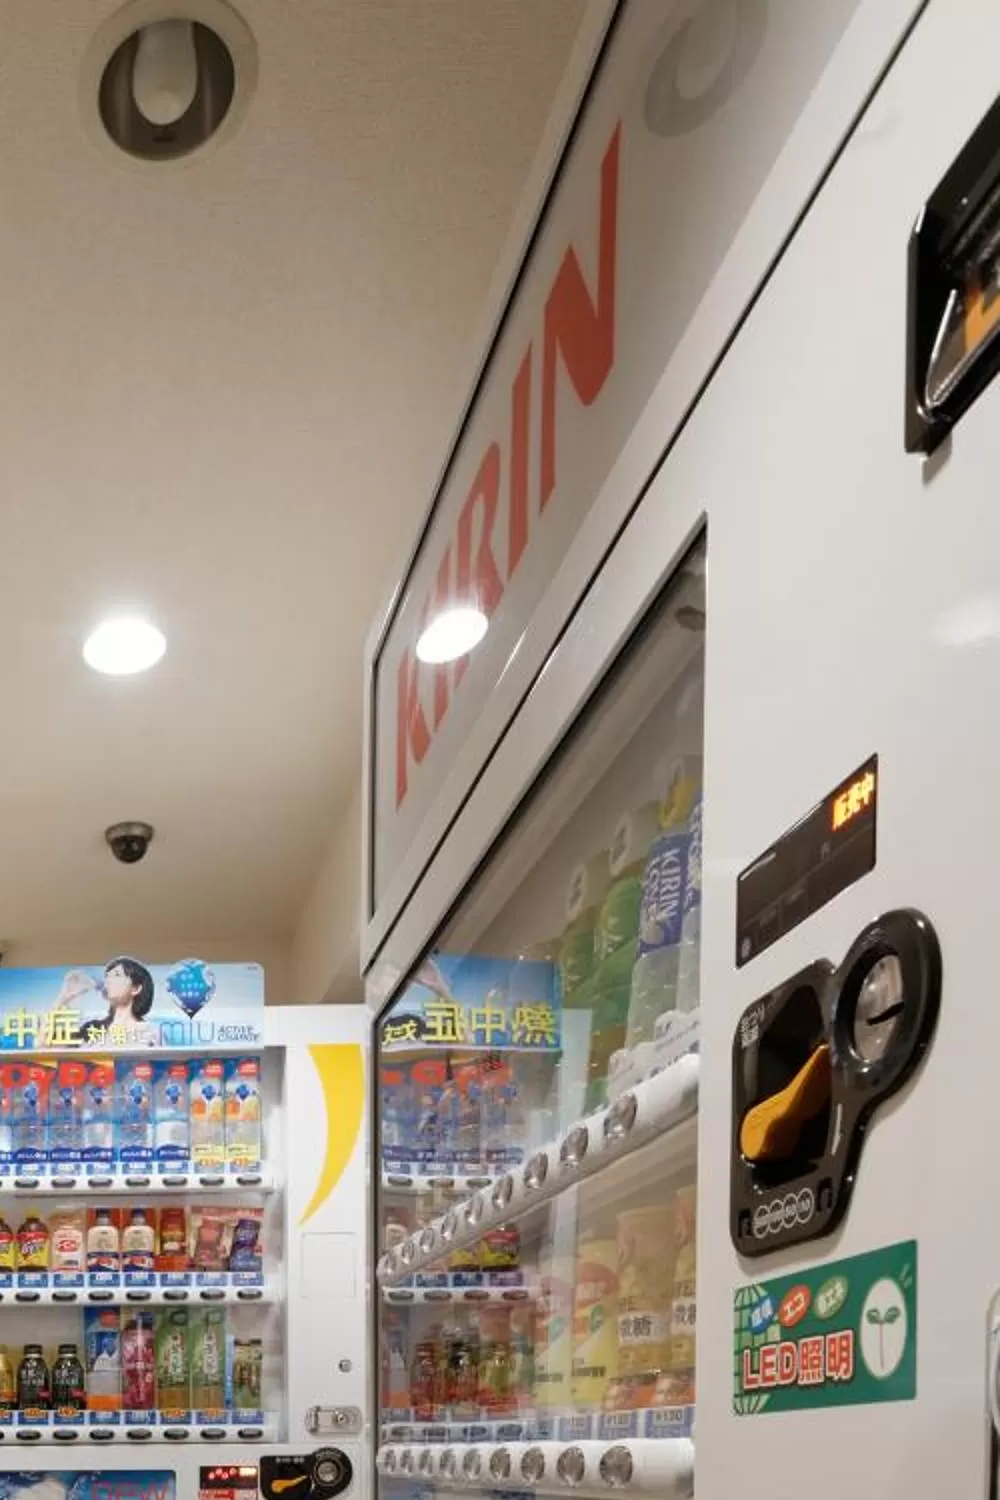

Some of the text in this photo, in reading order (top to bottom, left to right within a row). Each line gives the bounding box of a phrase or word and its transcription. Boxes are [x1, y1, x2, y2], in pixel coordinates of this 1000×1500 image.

[397, 119, 621, 806] KIRIN
[659, 847, 682, 924] KIRIN
[783, 1292, 805, 1318] エコ
[743, 1329, 854, 1390] LED照明
